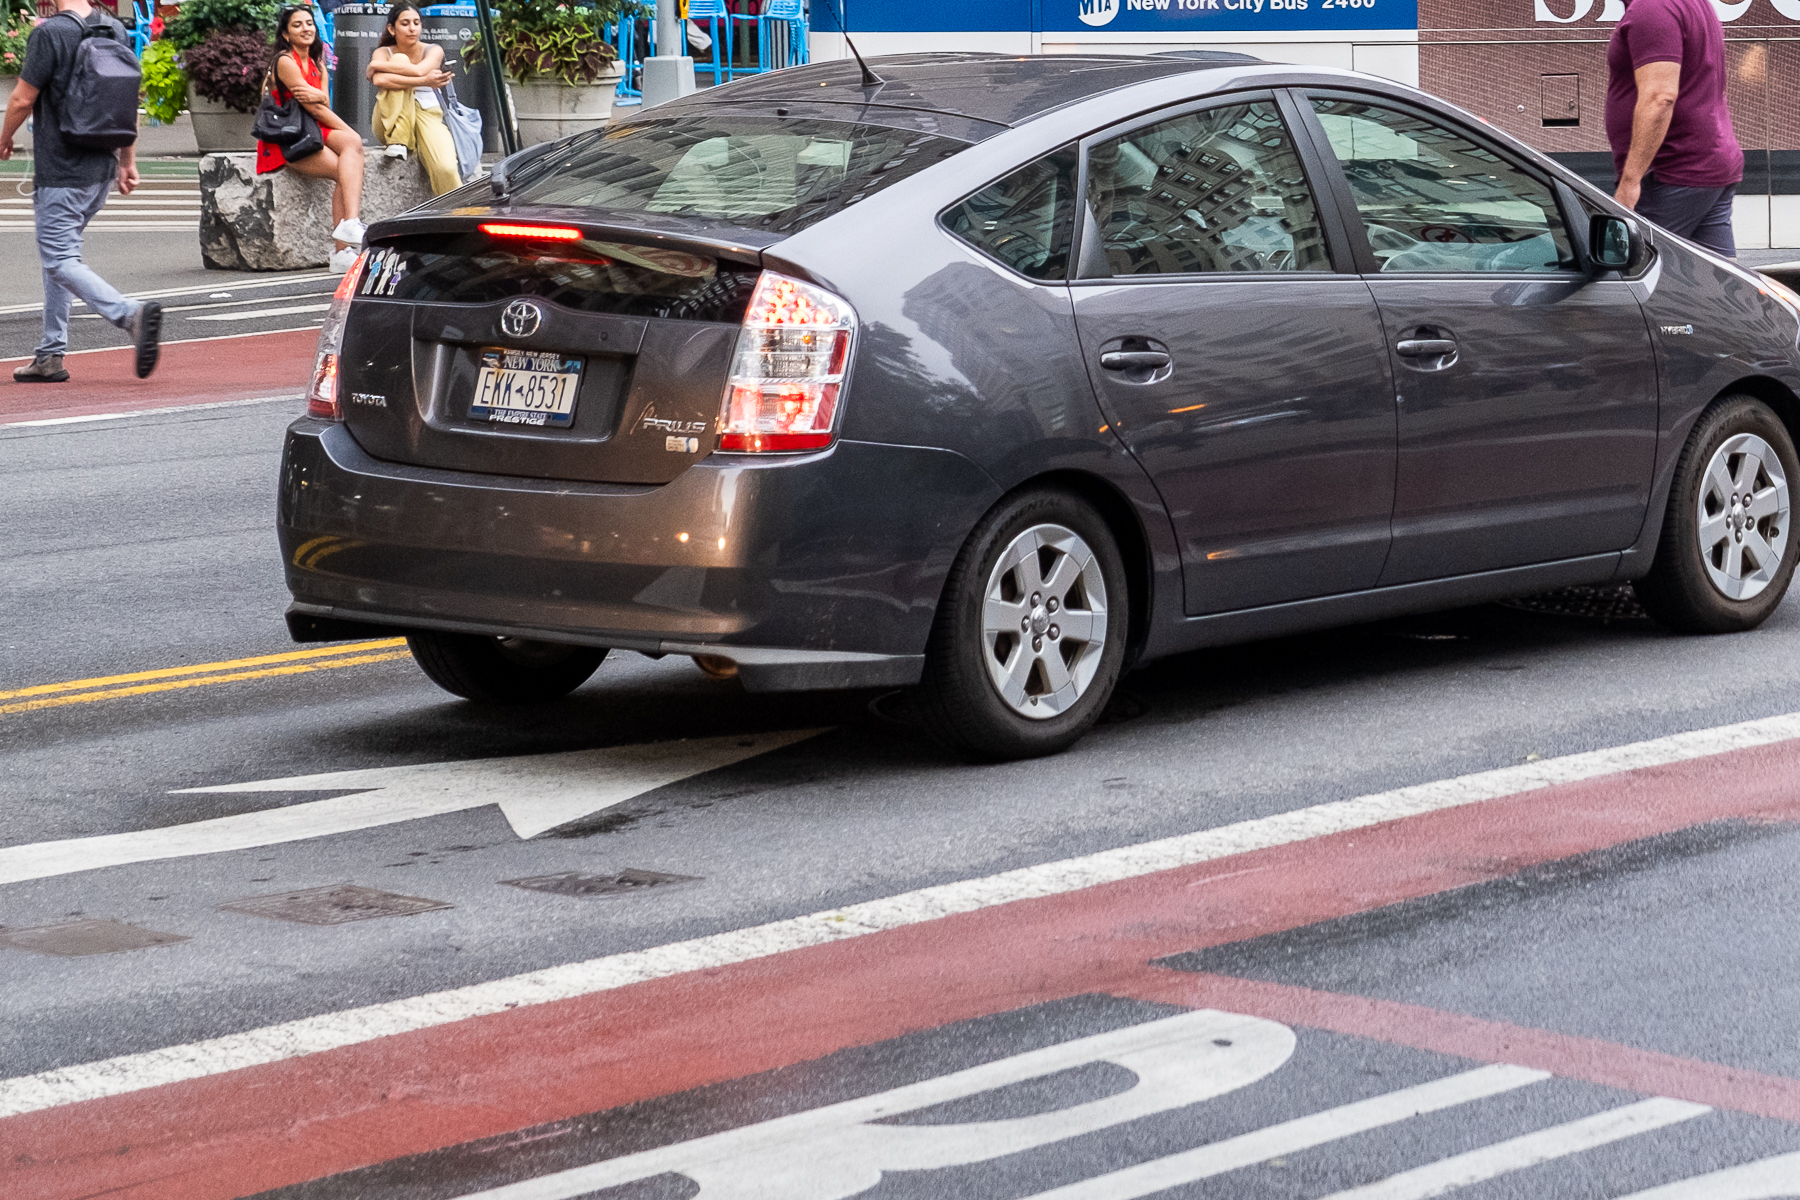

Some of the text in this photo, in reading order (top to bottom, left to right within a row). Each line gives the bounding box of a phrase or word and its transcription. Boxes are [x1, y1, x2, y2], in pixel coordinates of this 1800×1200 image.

[440, 9, 475, 17] RECYCLE
[503, 355, 558, 373] NEW YORK
[351, 392, 387, 408] TOYOTA
[489, 414, 546, 426] PRESTIGE
[643, 417, 707, 435] PRIUS
